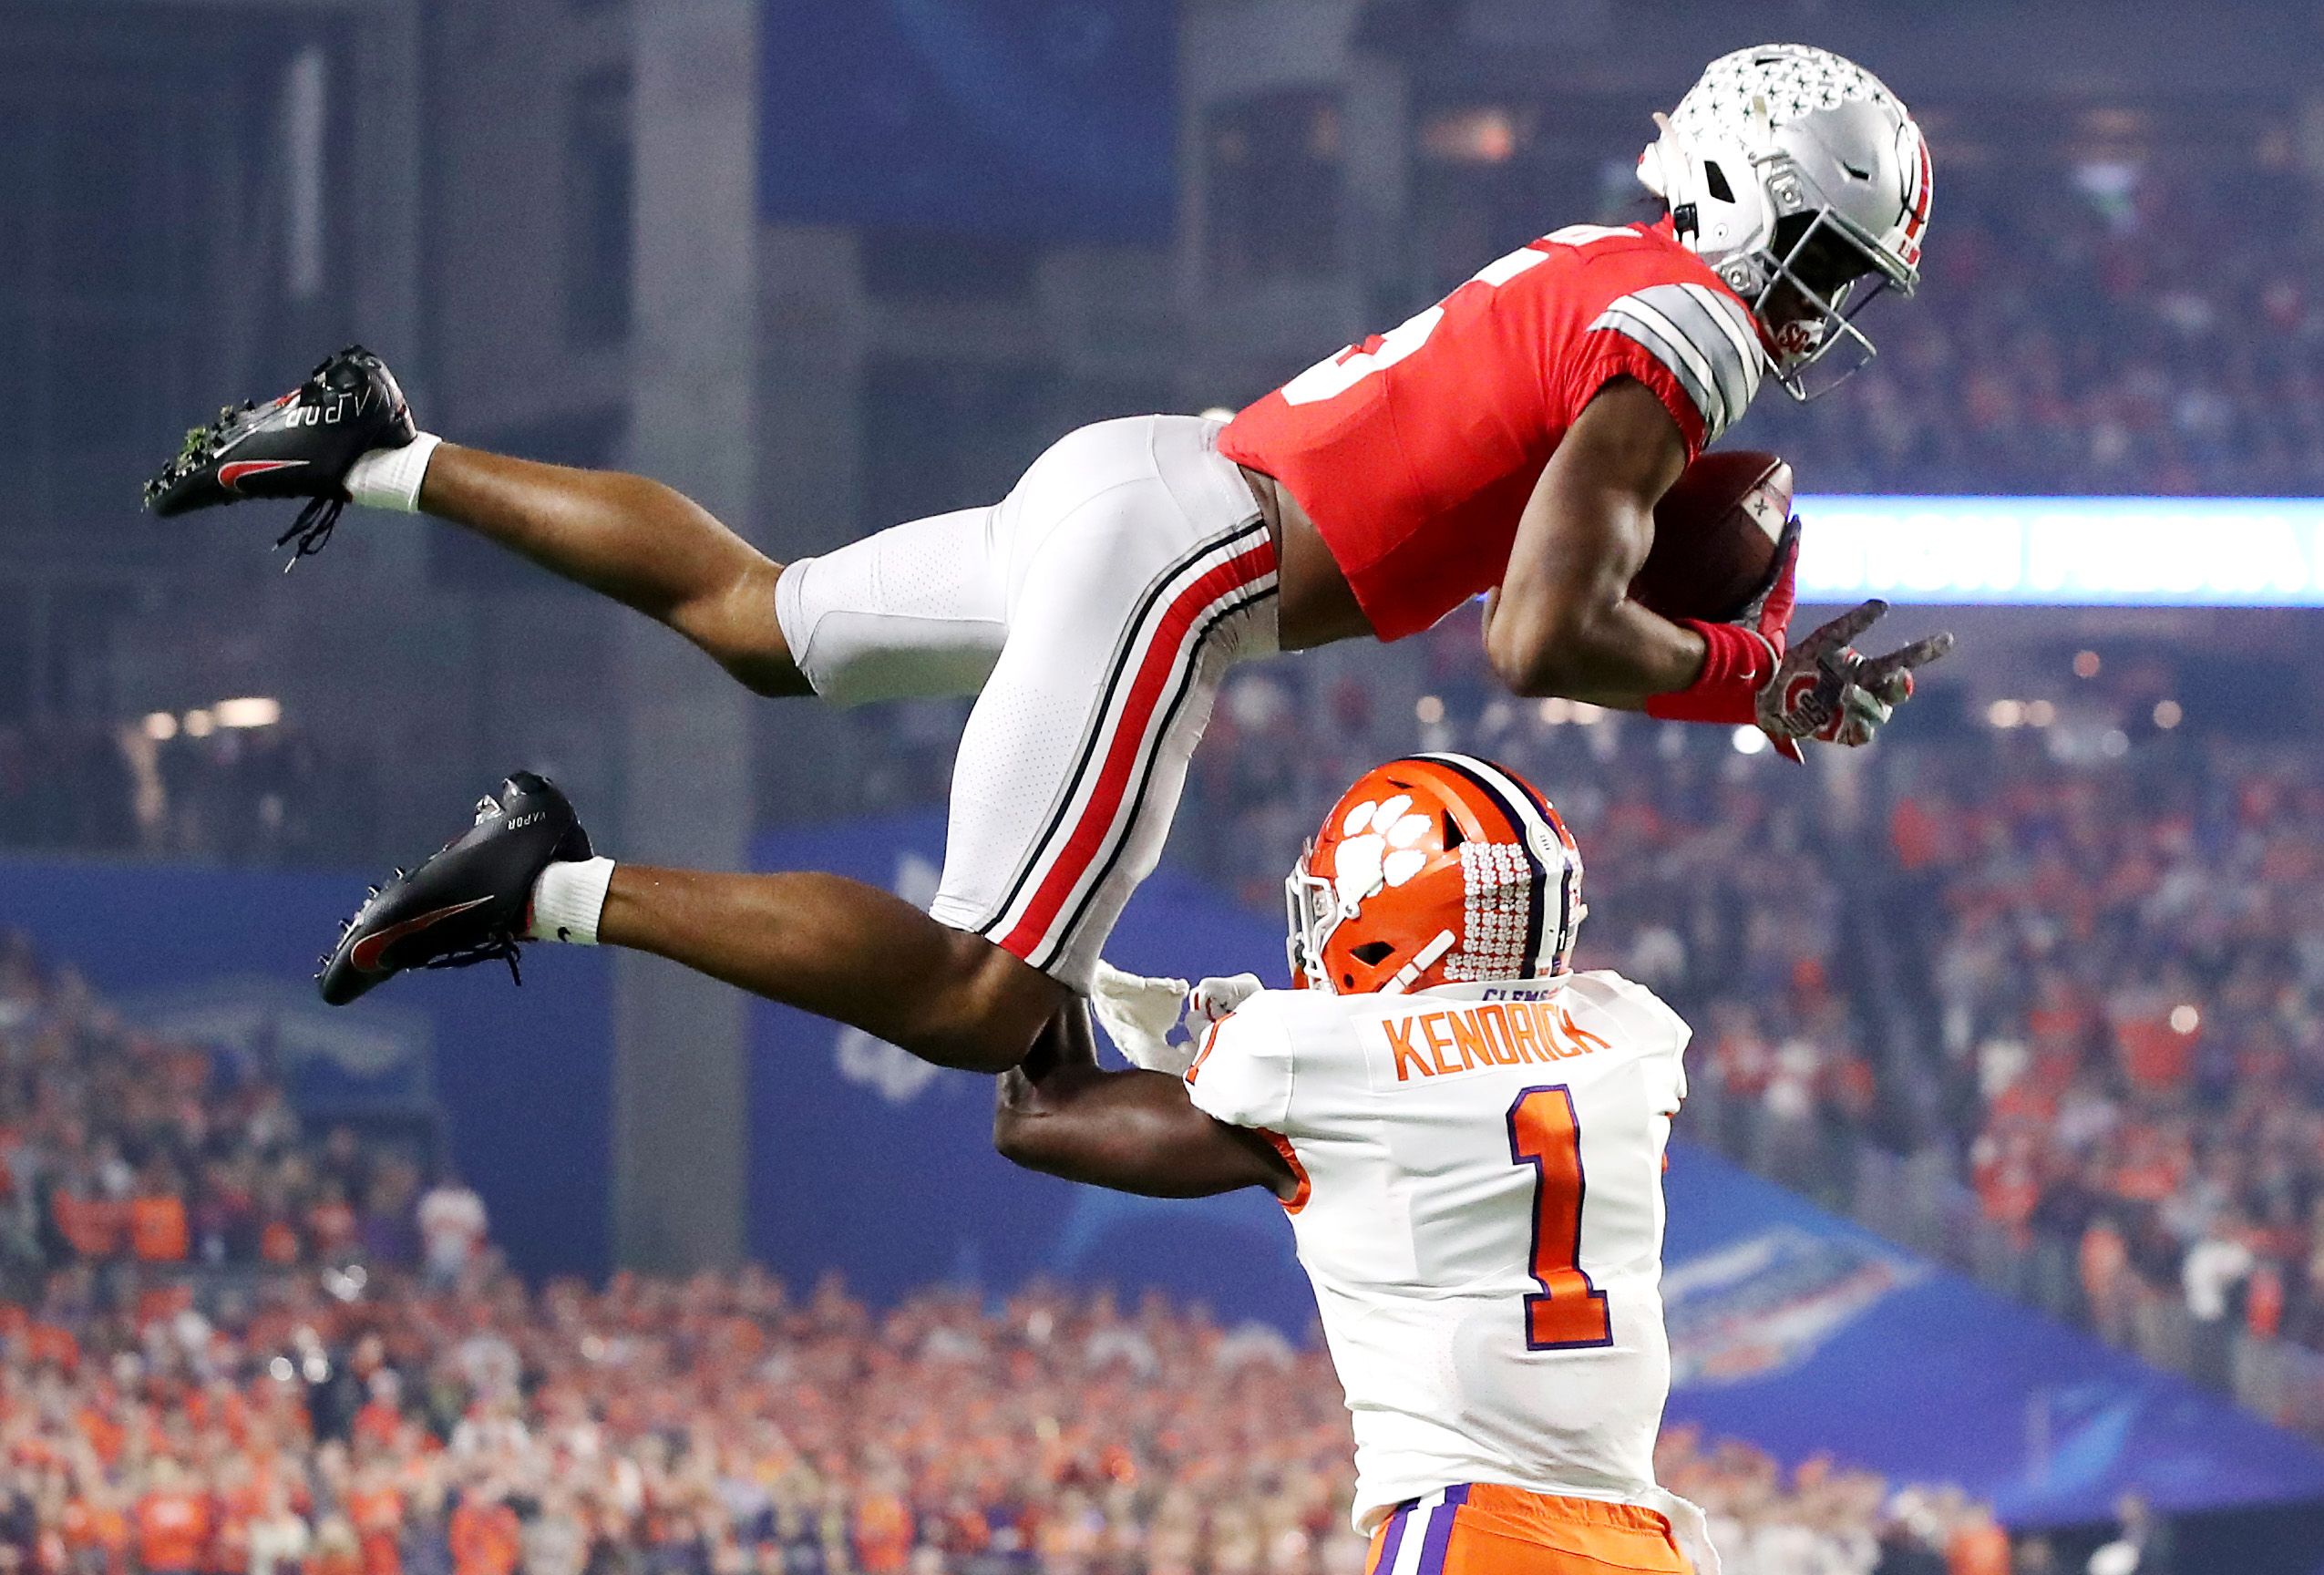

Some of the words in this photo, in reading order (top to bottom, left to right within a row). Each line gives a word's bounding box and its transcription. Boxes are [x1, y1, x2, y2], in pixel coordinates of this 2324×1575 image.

[508, 811, 546, 830] VAPOR
[1382, 1003, 1612, 1082] KENDRICK
[1506, 1083, 1614, 1351] 1
